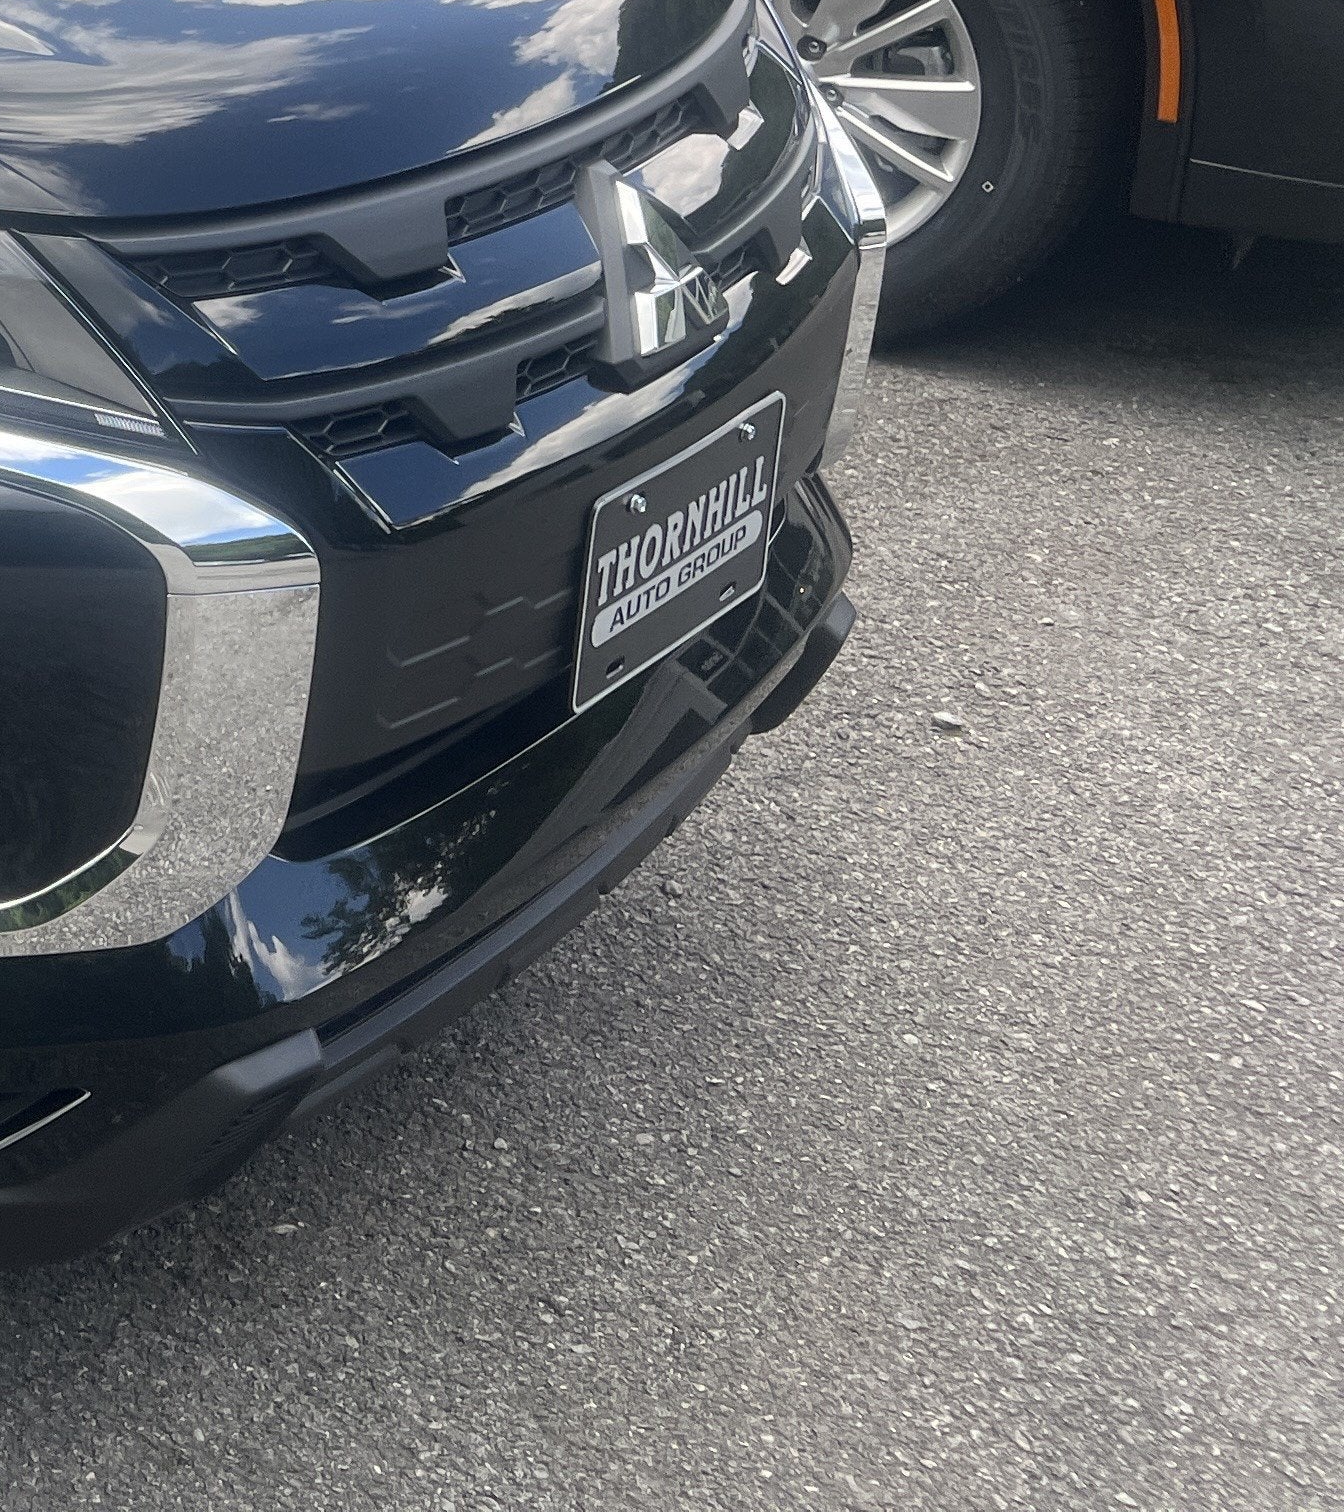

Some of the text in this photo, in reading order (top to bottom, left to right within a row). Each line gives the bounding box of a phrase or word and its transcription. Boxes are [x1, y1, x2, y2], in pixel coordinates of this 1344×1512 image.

[596, 455, 768, 607] THORNHILL
[608, 524, 747, 633] AUTO GROUP
